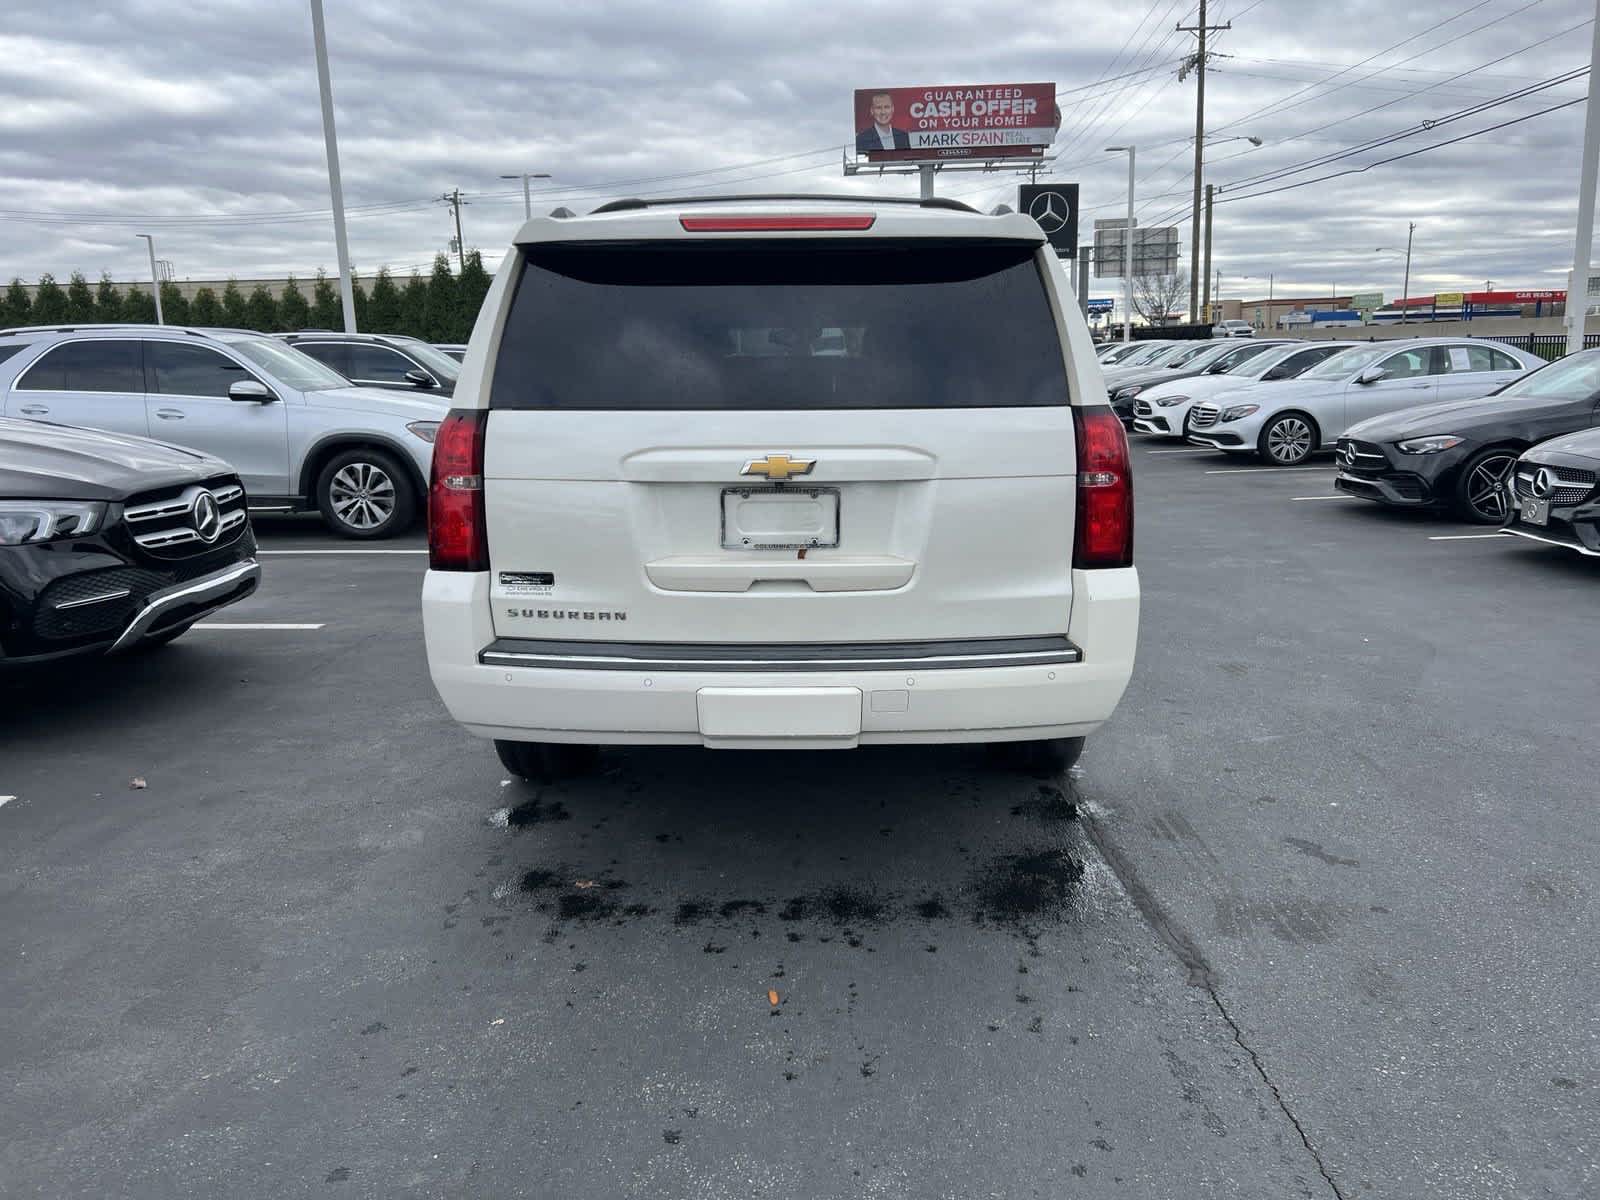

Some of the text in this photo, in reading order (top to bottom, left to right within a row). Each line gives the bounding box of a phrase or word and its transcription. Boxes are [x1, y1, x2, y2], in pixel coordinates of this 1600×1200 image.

[924, 88, 1023, 101] GUARANTEED
[910, 98, 1038, 118] CASH OFFER
[918, 115, 1028, 129] ON YOUR HOME!
[919, 131, 1005, 147] MARK SPAIN
[507, 608, 627, 621] SUBURBAN
